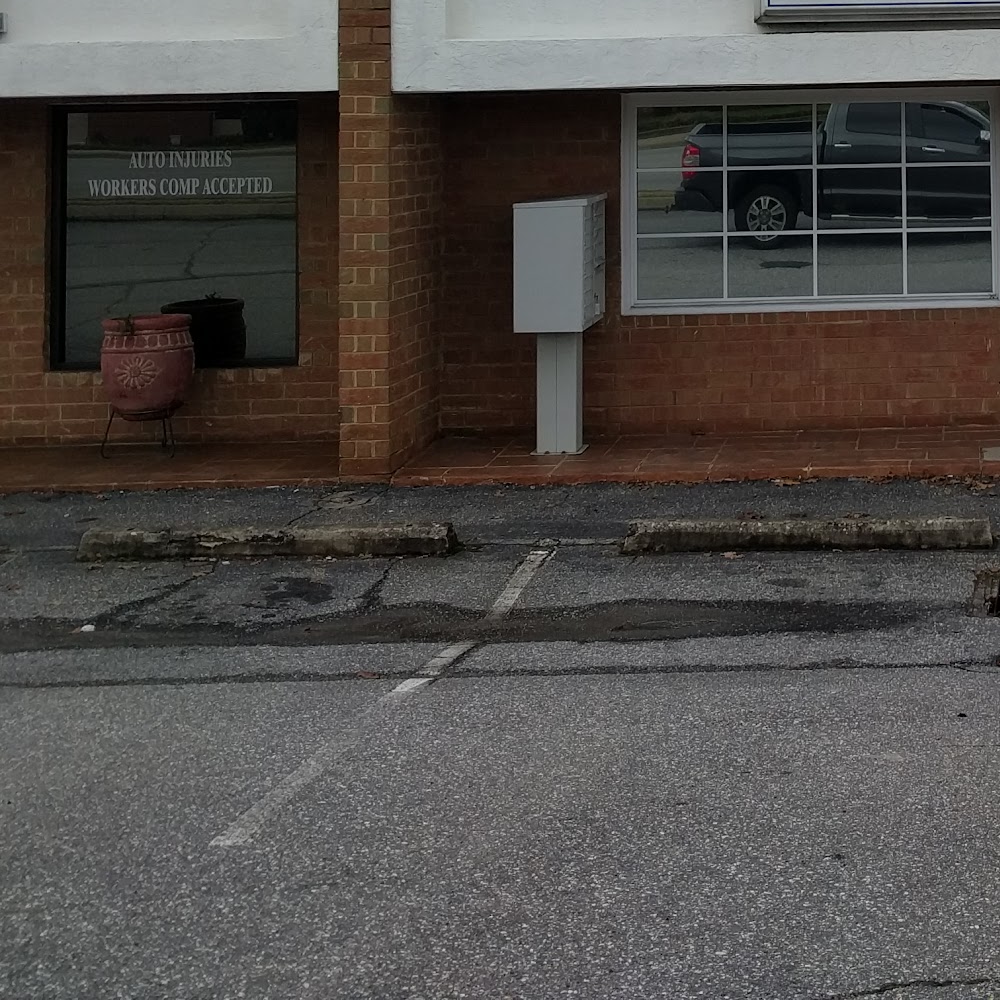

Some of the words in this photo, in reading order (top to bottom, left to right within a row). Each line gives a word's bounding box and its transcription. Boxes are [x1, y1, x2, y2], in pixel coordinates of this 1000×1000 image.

[128, 151, 166, 169] AUTO
[168, 150, 232, 168] INJURIES
[87, 178, 157, 197] WORKERS
[159, 177, 200, 196] COMP
[202, 176, 273, 195] ACCEPTED
